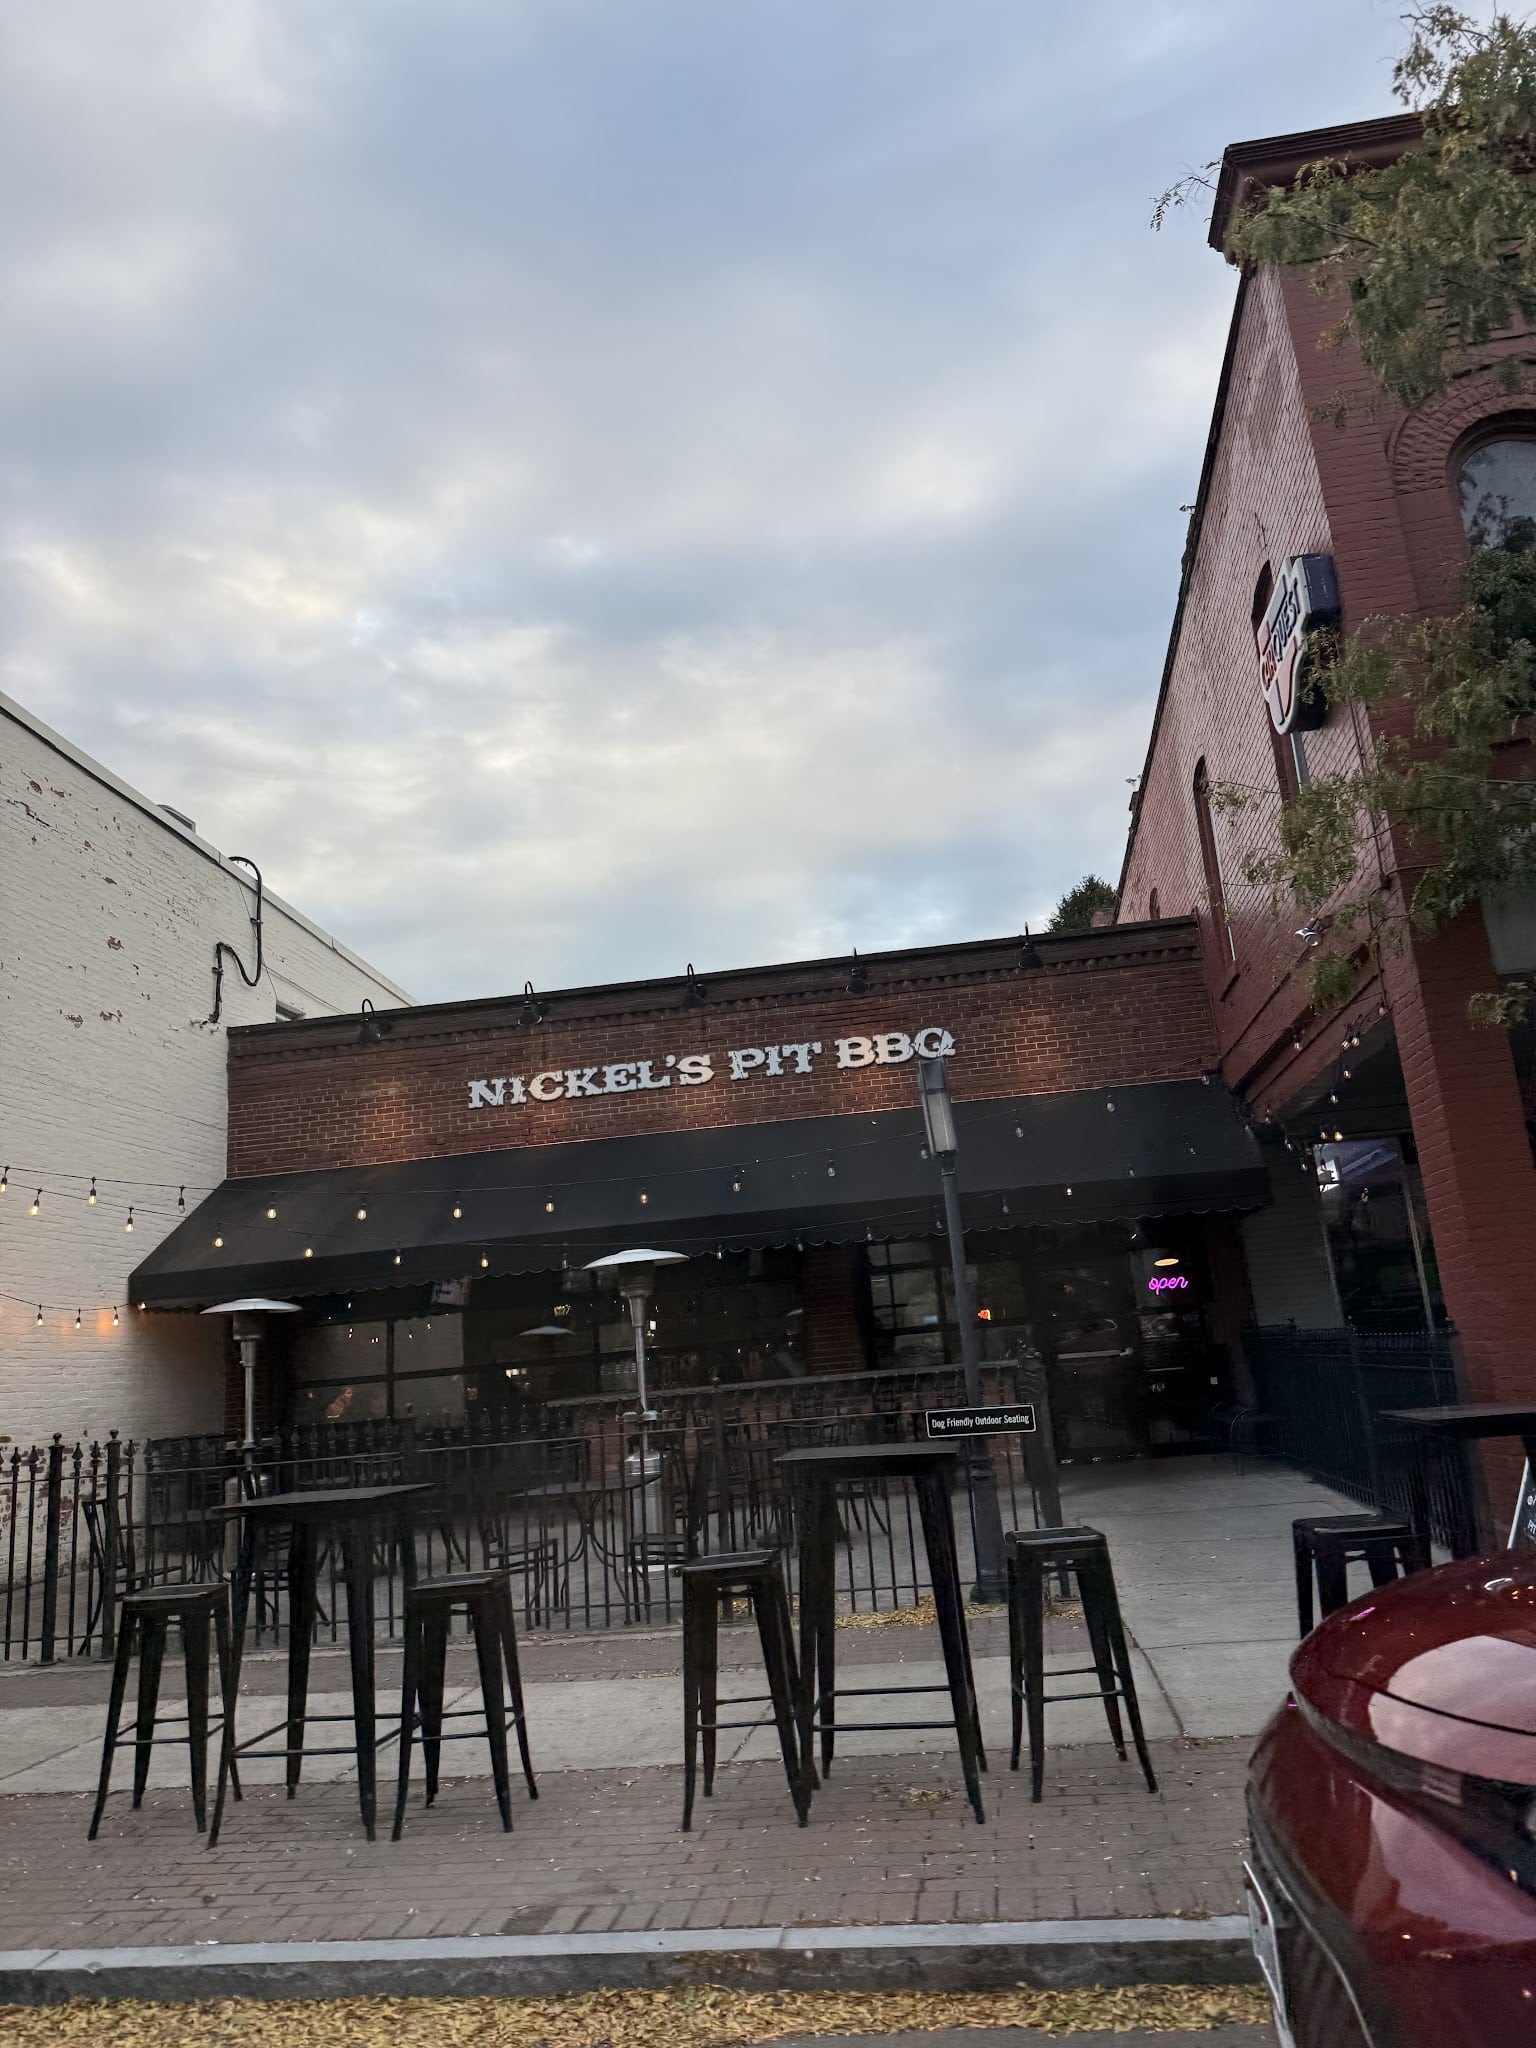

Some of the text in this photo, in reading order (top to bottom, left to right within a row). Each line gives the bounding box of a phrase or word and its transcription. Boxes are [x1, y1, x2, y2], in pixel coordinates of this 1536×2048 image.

[467, 1027, 956, 1109] NICKEL'S PIT BBQ
[1149, 1276, 1188, 1295] open
[932, 1414, 1029, 1429] Dog Friendly Outdoor Seating
